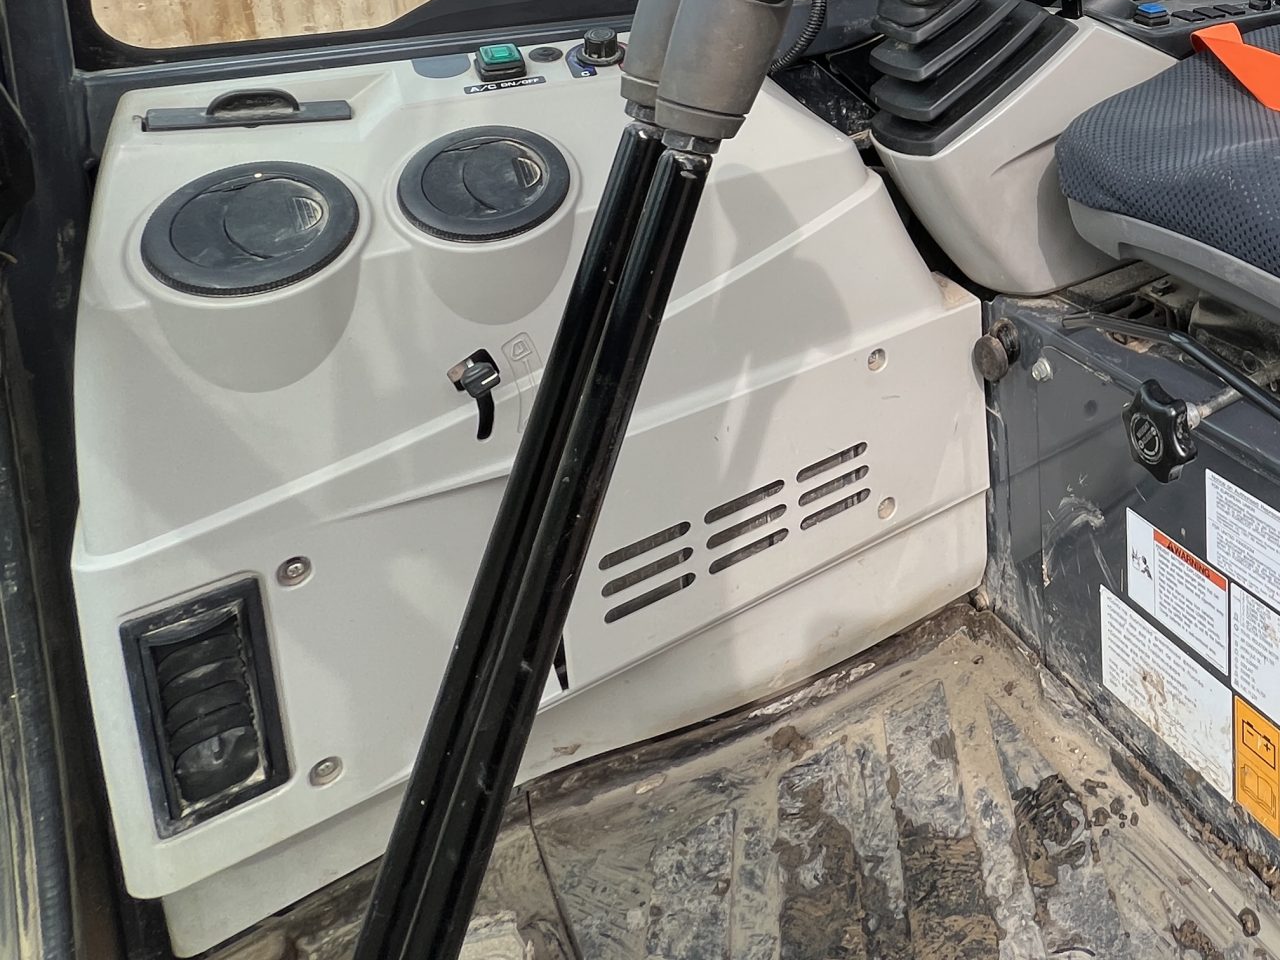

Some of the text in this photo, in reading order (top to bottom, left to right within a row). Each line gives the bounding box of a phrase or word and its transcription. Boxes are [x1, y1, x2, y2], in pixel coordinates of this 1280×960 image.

[470, 78, 540, 93] A/C ON/OFF
[1173, 548, 1210, 579] WARNING
